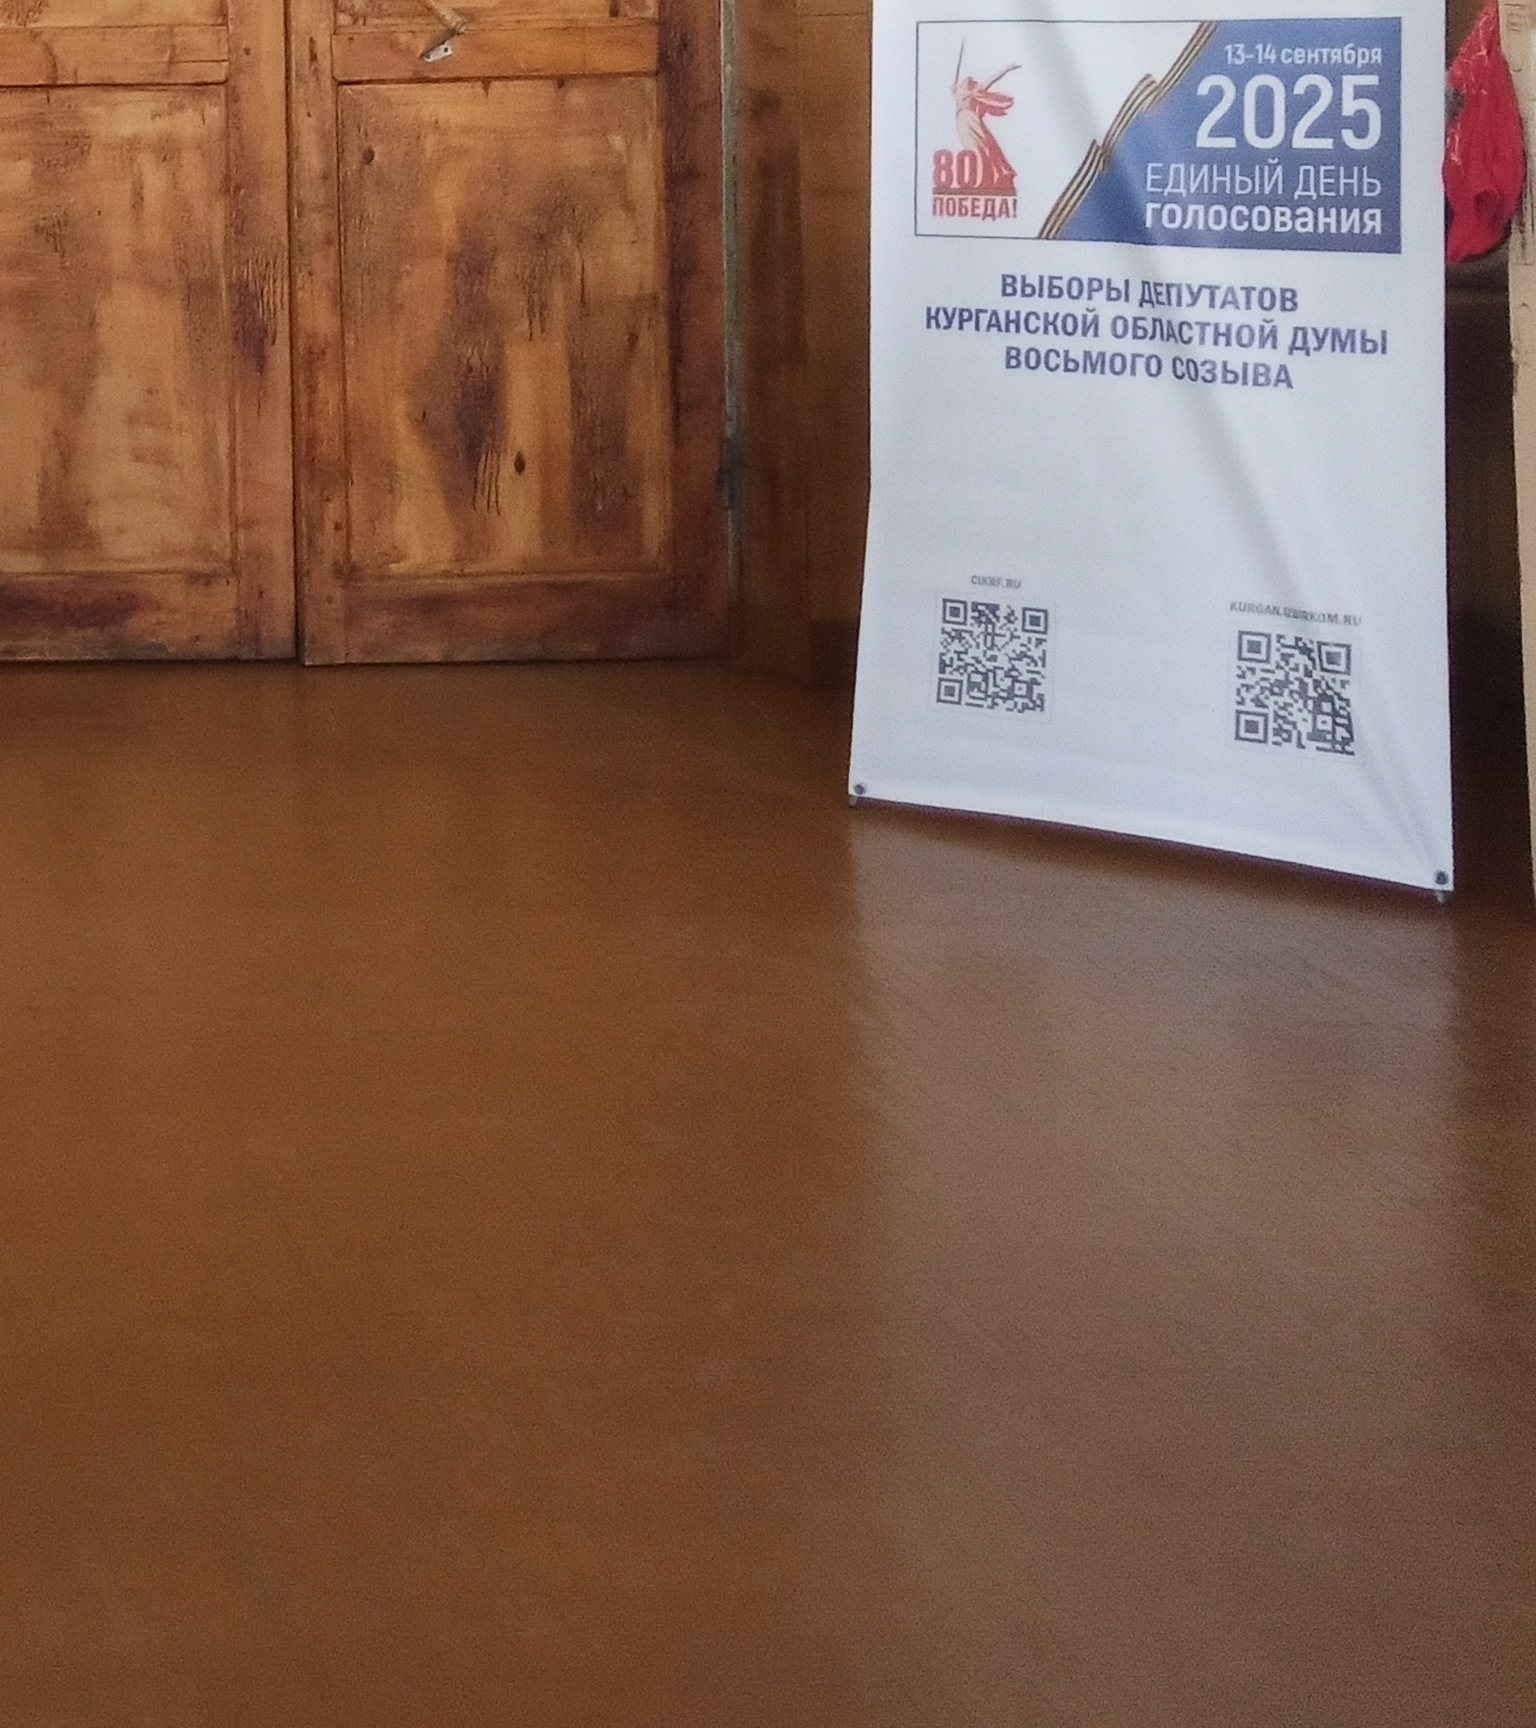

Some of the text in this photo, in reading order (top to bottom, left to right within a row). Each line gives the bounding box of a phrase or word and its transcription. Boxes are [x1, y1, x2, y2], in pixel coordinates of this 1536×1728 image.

[1225, 42, 1382, 67] 13-14 сентября
[1196, 74, 1382, 150] 2025
[1145, 157, 1382, 199] ЕДИНЫЙ ДЕНЬ
[932, 195, 1018, 221] ПОБЕДА!
[1000, 274, 1299, 313] ВЫБОРЫ ДЕПУТАТОВ
[925, 304, 1388, 357] КУРГАНСКОЙ ОБЛАСТНОЙ ДУМЫ
[1004, 347, 1293, 390] ВОСЬМОГО СОЗЫВА
